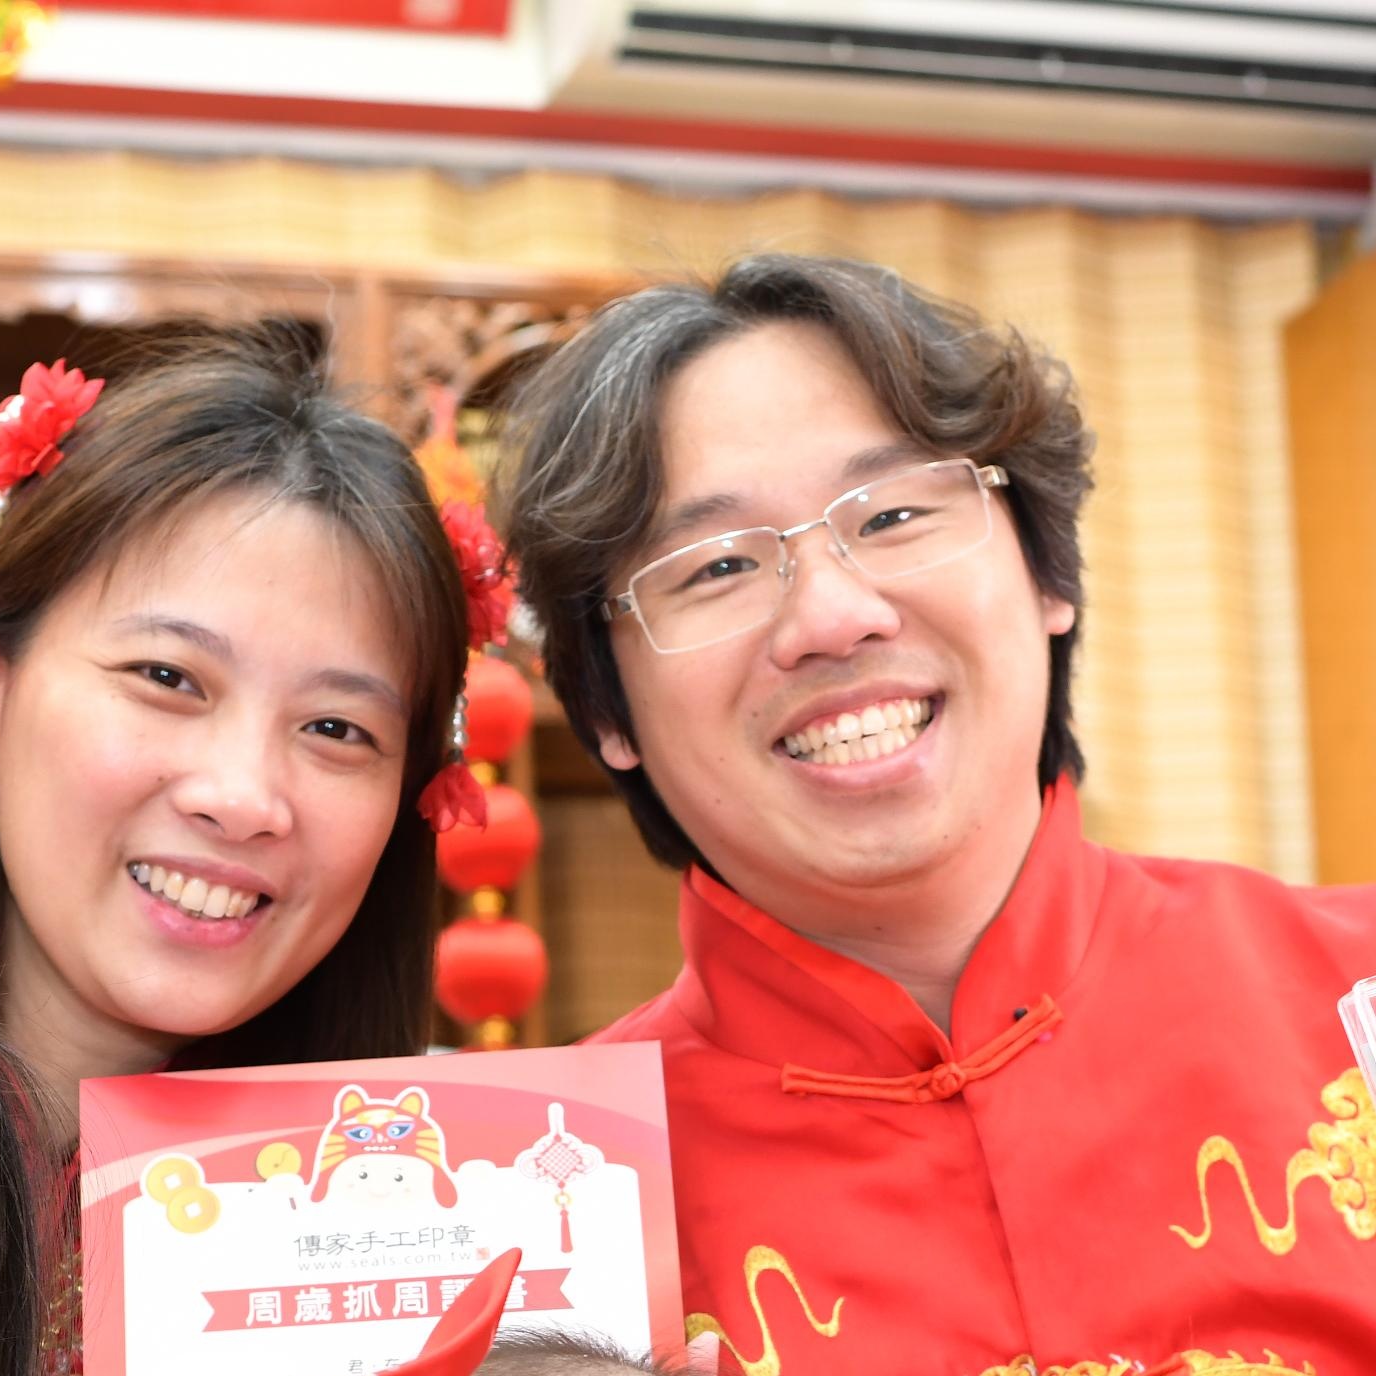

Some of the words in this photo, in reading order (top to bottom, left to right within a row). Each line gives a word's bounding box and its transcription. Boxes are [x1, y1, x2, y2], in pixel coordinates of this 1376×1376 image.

[293, 1224, 477, 1258] 傳家手工印章
[297, 1250, 473, 1272] www.seals.com.tw
